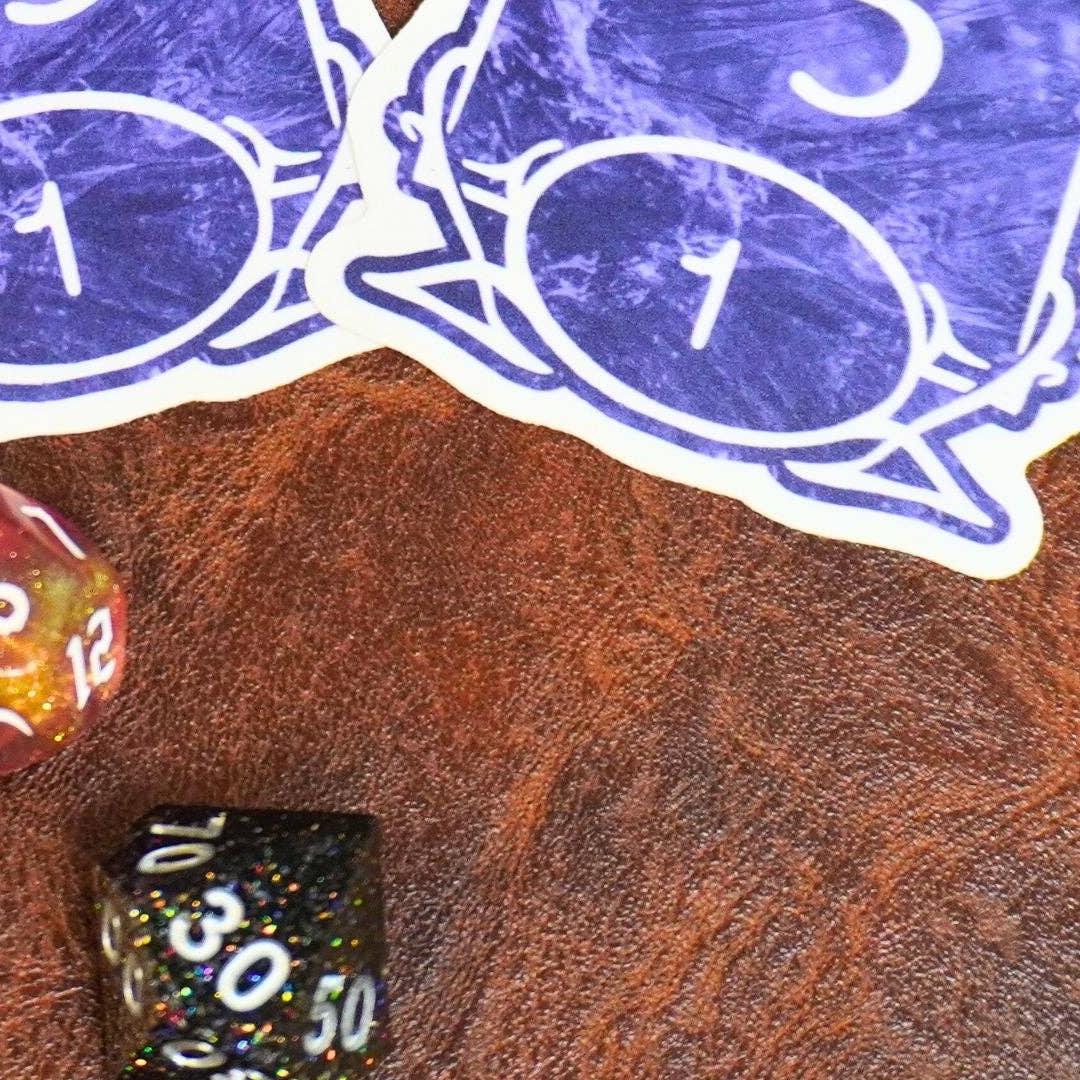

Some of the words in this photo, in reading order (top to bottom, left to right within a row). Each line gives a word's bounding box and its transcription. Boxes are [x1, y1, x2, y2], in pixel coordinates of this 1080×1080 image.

[14, 180, 82, 298] 1
[680, 240, 740, 350] 1
[65, 607, 117, 711] 12
[169, 886, 291, 1012] 30
[303, 973, 376, 1056] 50
